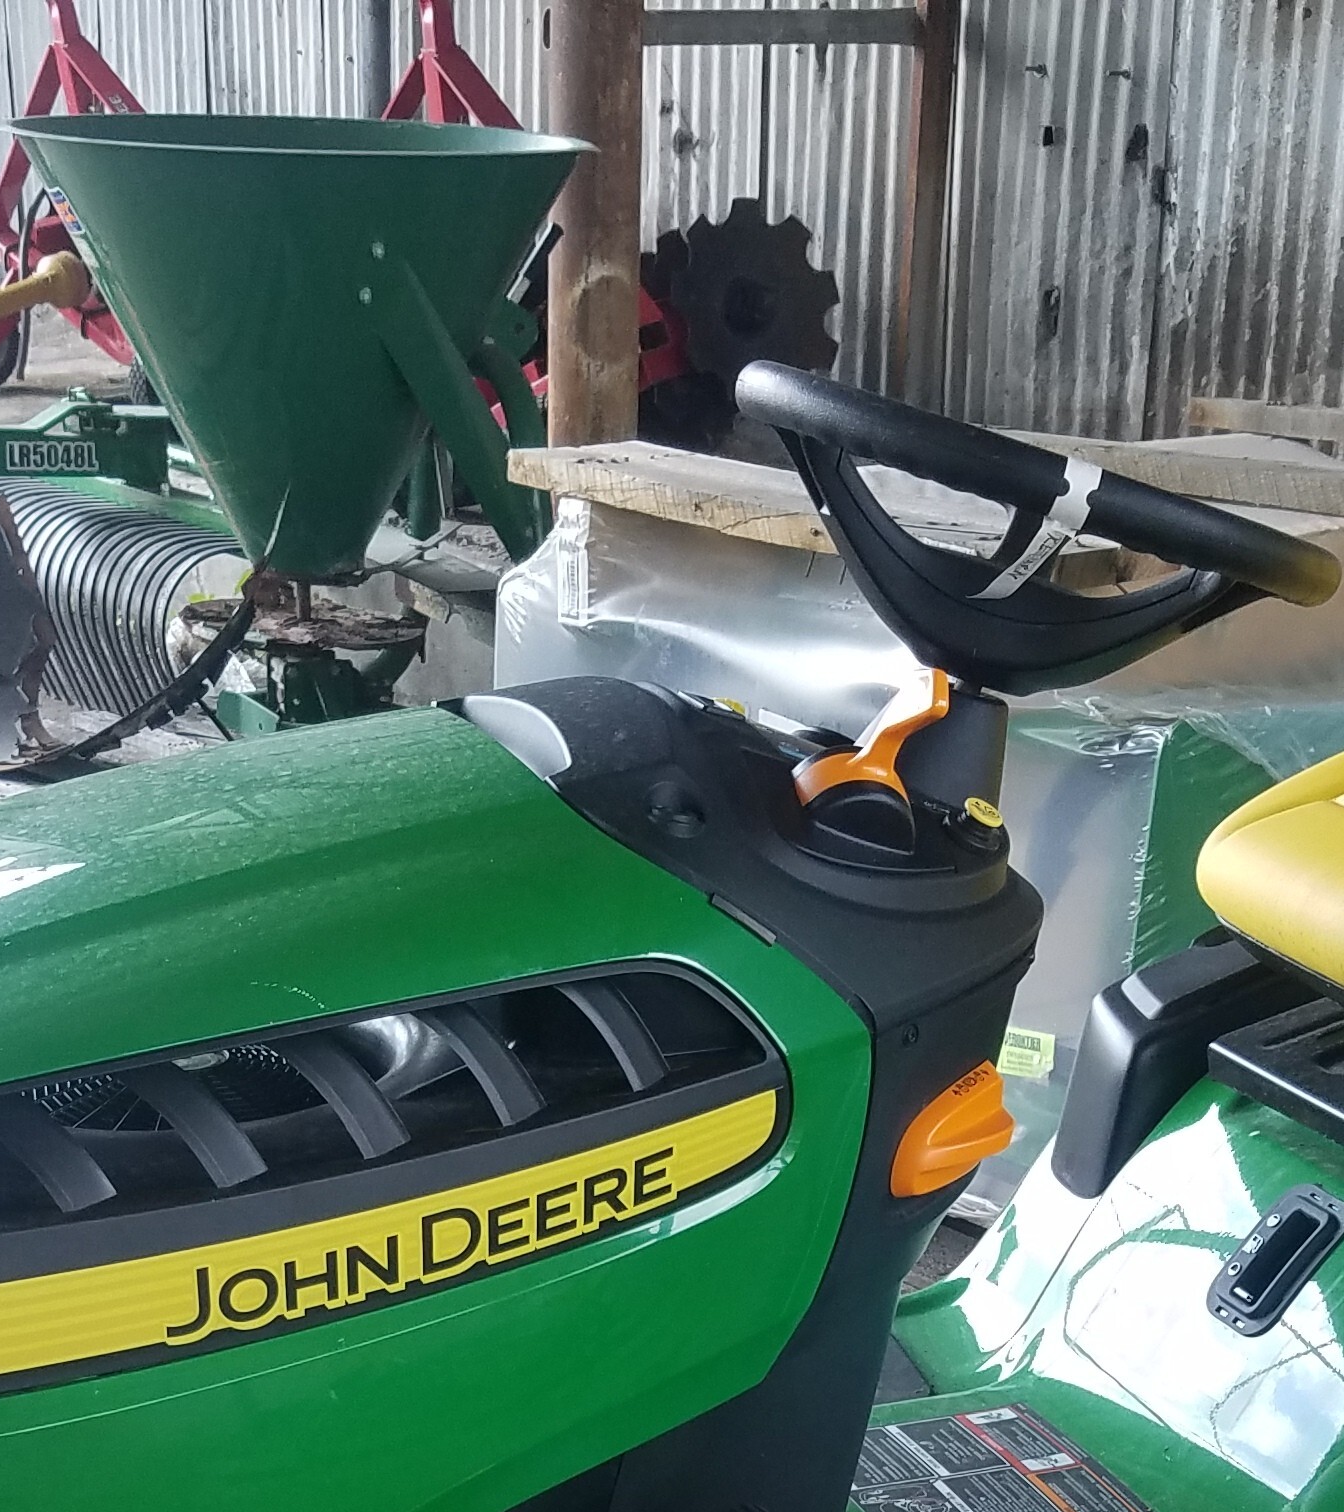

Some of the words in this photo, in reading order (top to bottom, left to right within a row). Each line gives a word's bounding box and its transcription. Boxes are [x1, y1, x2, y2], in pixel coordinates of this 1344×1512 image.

[7, 442, 98, 470] LR5048L
[166, 1235, 398, 1338] JOHN
[422, 1147, 674, 1276] DEERE
